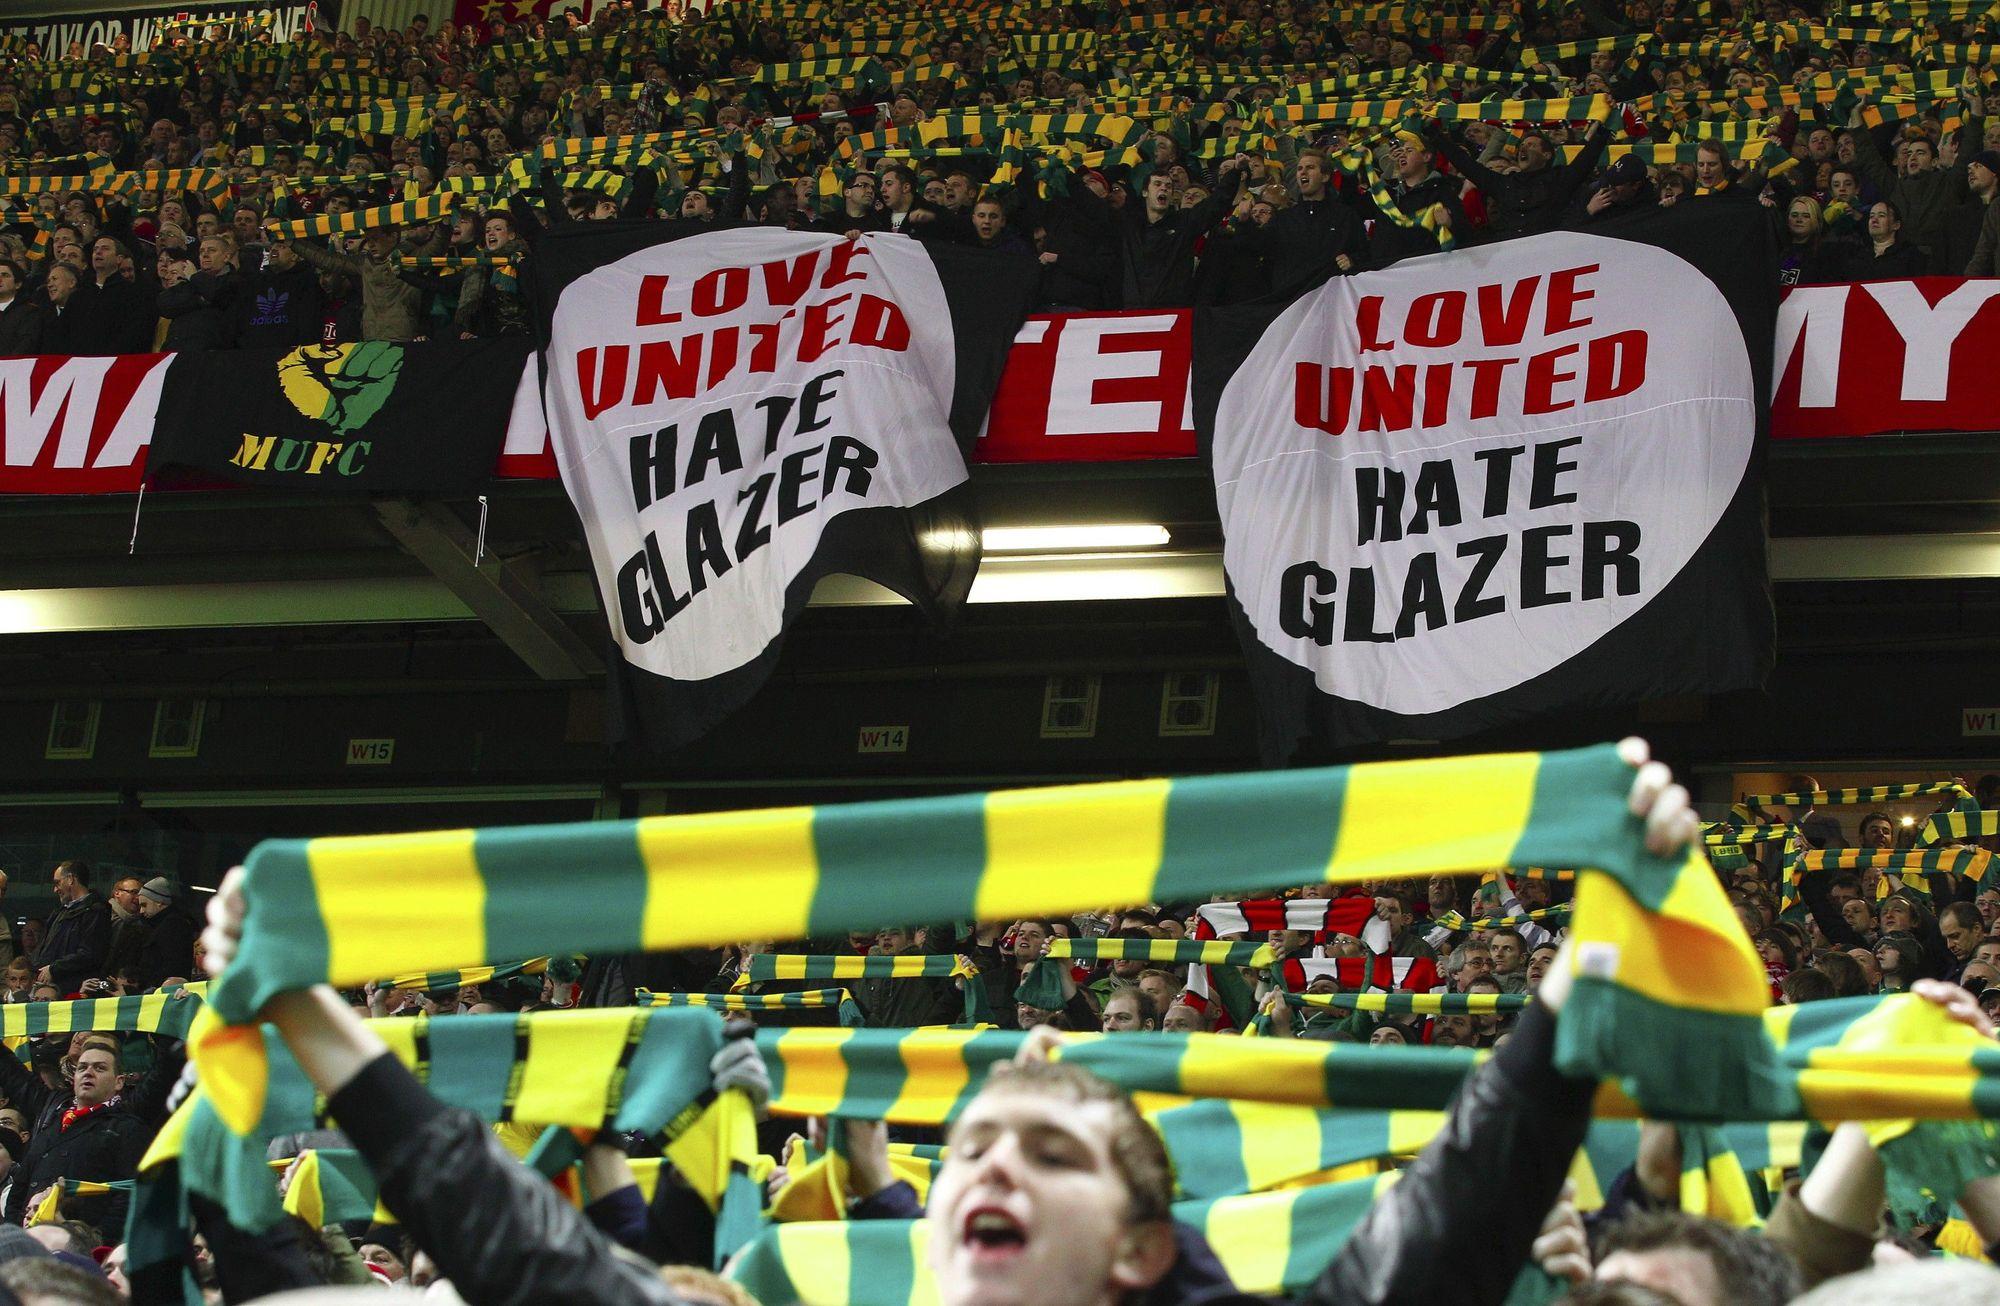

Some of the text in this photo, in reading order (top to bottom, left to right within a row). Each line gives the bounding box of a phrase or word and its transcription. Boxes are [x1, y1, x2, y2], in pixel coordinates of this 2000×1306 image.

[637, 239, 873, 326] LOVE
[1356, 264, 1600, 354] LOVE
[577, 293, 911, 420] UNITED
[1295, 330, 1648, 436] UNITED
[229, 433, 371, 475] MUFC
[630, 369, 845, 513] HATE
[617, 436, 879, 644] GLAZER
[1355, 436, 1583, 546] HATE
[1280, 520, 1642, 646] GLAZER
[352, 743, 389, 759] W15
[861, 731, 903, 747] W14
[1966, 713, 2000, 730] W1
